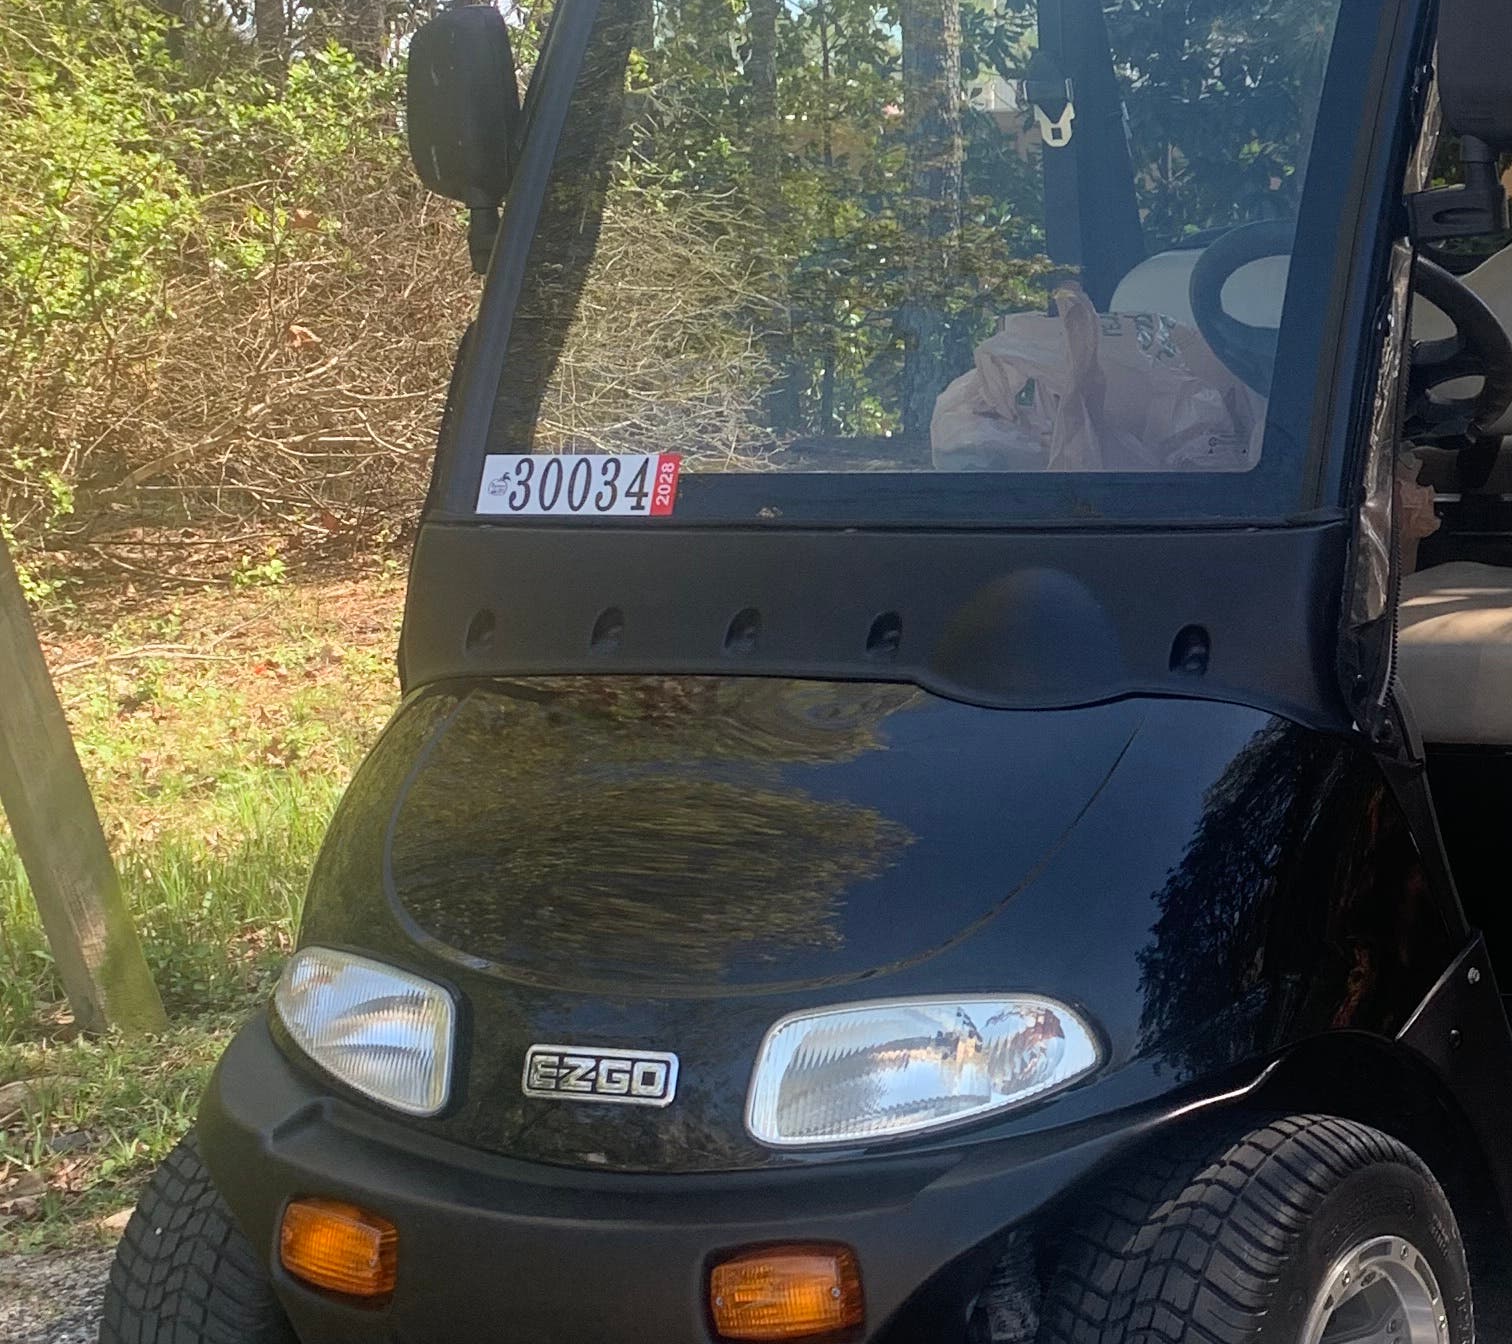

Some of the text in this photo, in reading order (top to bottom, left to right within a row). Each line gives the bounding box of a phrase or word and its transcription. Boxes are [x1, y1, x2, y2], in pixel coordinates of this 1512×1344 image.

[508, 456, 650, 512] 30034
[655, 461, 675, 507] 2028
[529, 1054, 667, 1097] EZGO
